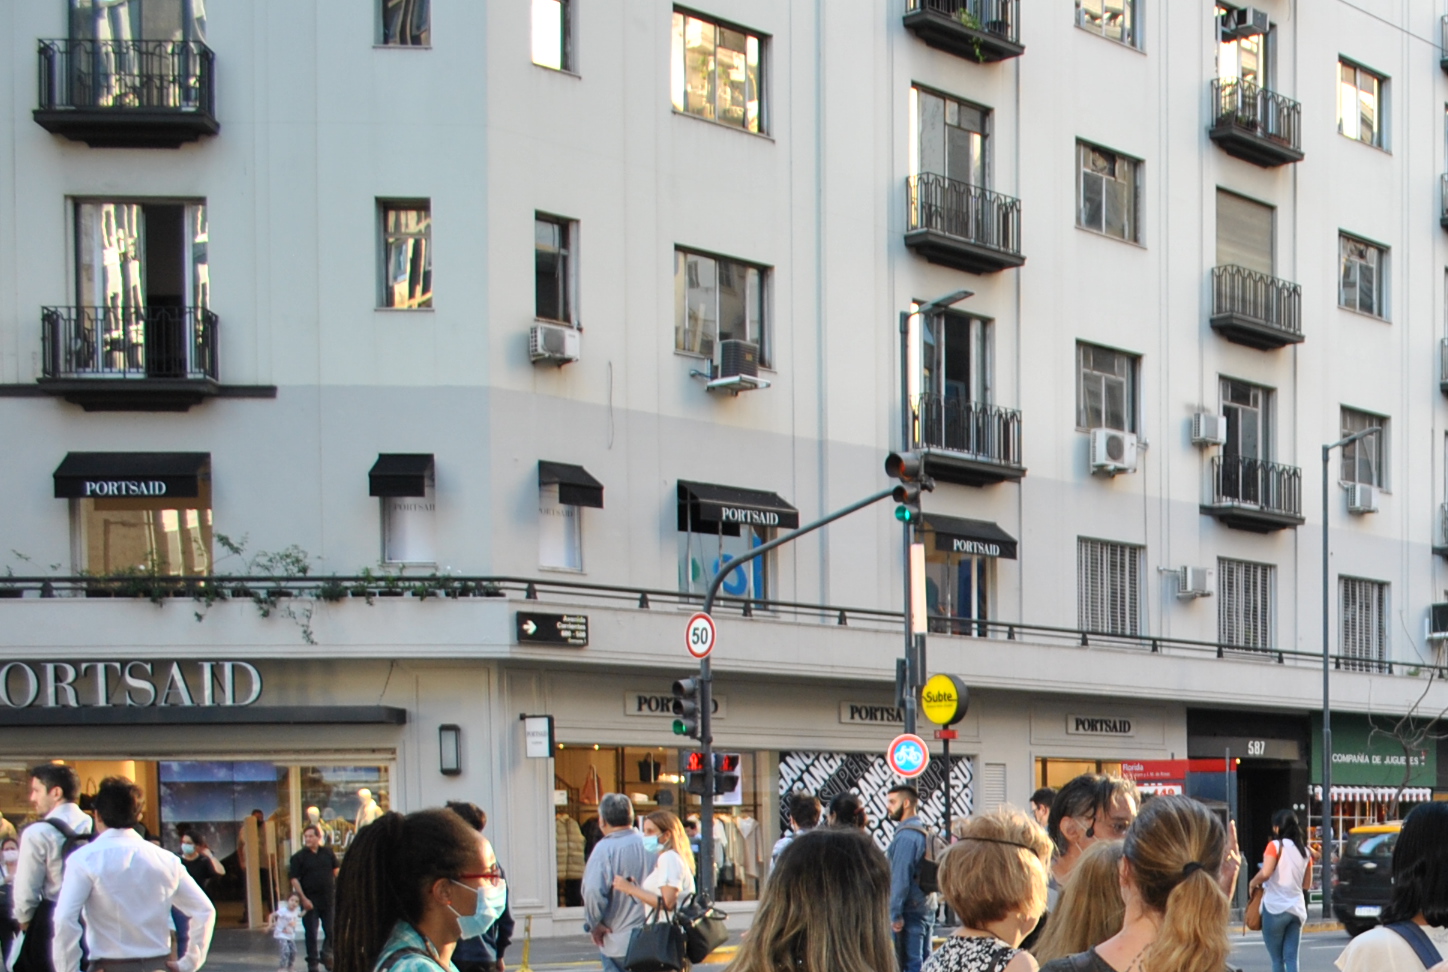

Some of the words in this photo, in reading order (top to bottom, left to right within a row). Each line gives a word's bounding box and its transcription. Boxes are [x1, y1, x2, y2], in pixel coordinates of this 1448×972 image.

[85, 481, 167, 496] PORTSAID
[721, 507, 779, 526] PORTSAID
[953, 538, 1000, 556] PORTSAID
[691, 627, 709, 645] 50
[924, 690, 955, 703] Subte
[1075, 717, 1131, 734] PORTSAID
[1248, 741, 1266, 756] 587
[1122, 763, 1144, 771] Florida
[1372, 755, 1381, 765] DE
[1384, 756, 1419, 766] JUGUEES
